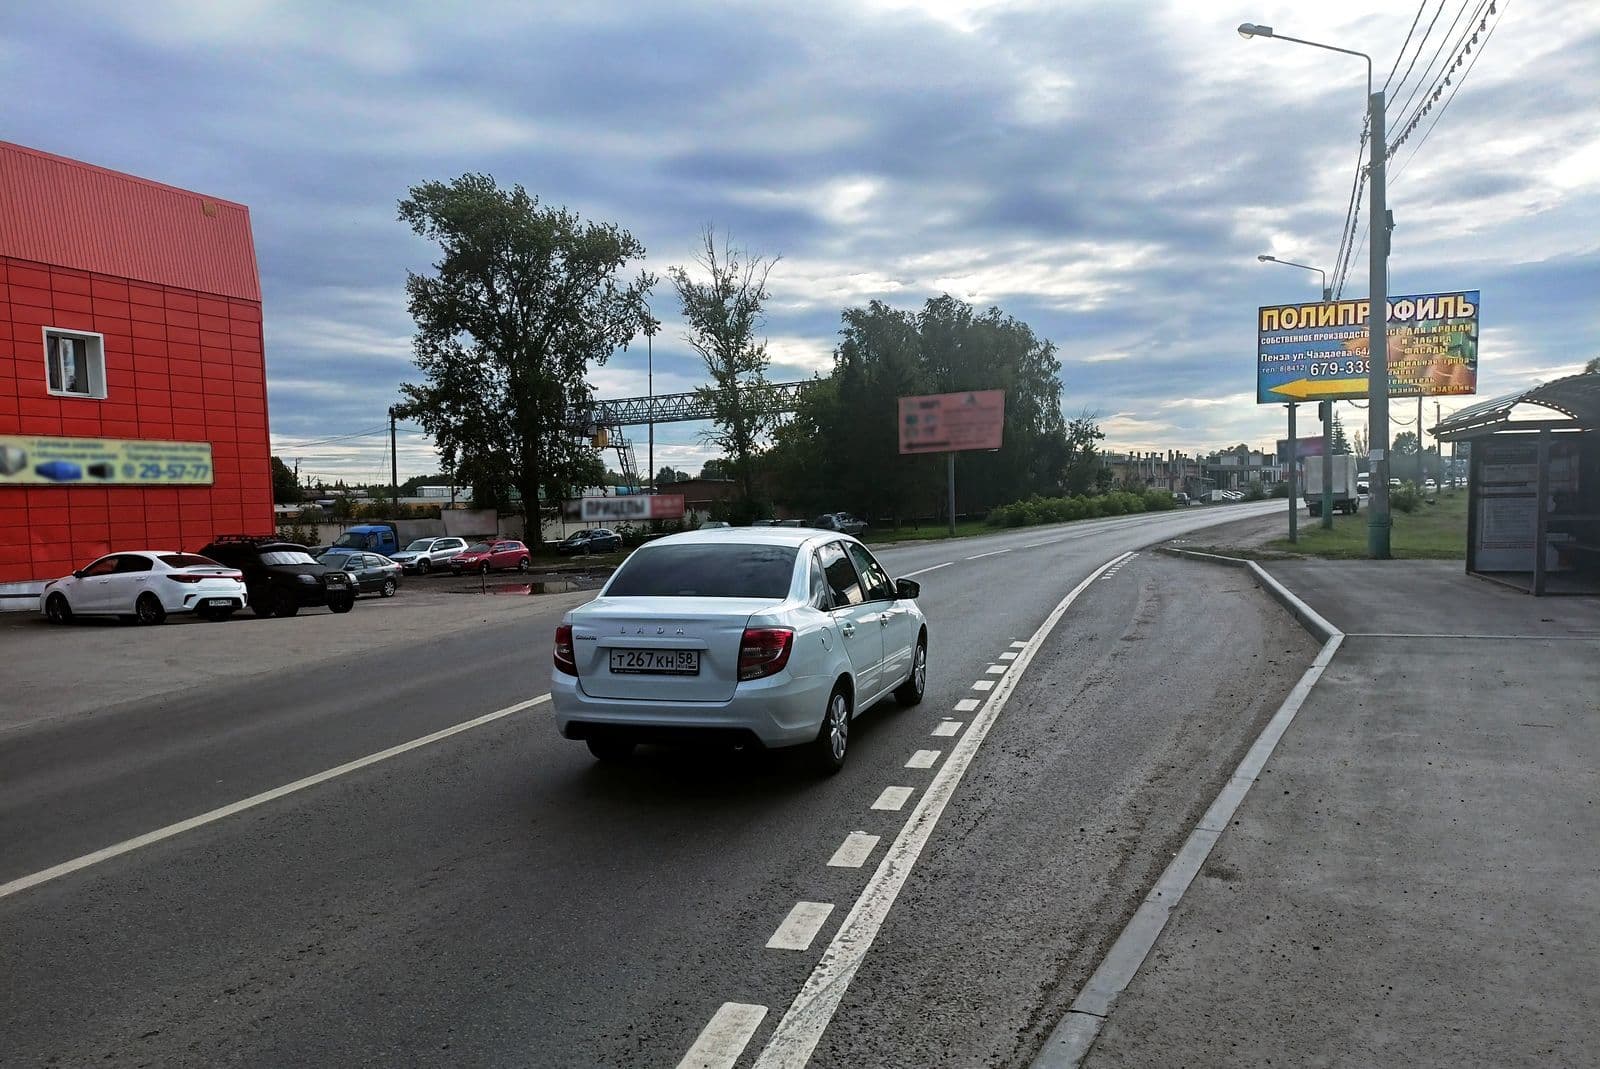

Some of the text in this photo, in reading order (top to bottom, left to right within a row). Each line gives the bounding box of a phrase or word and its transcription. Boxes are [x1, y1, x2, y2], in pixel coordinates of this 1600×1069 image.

[1431, 324, 1473, 334] КРОВЛИ
[1260, 330, 1370, 345] СОБСТВЕННОЕ ПРОИЗВОДСТВ
[1413, 335, 1452, 344] ЗАБОРА
[1404, 346, 1449, 355] ФАСАДЫ
[1261, 353, 1290, 363] Пенза
[1388, 359, 1438, 369] рофильная
[1388, 369, 1416, 377] емент
[1388, 377, 1435, 386] теплитель
[620, 627, 684, 635] LADA
[678, 653, 693, 665] 58
